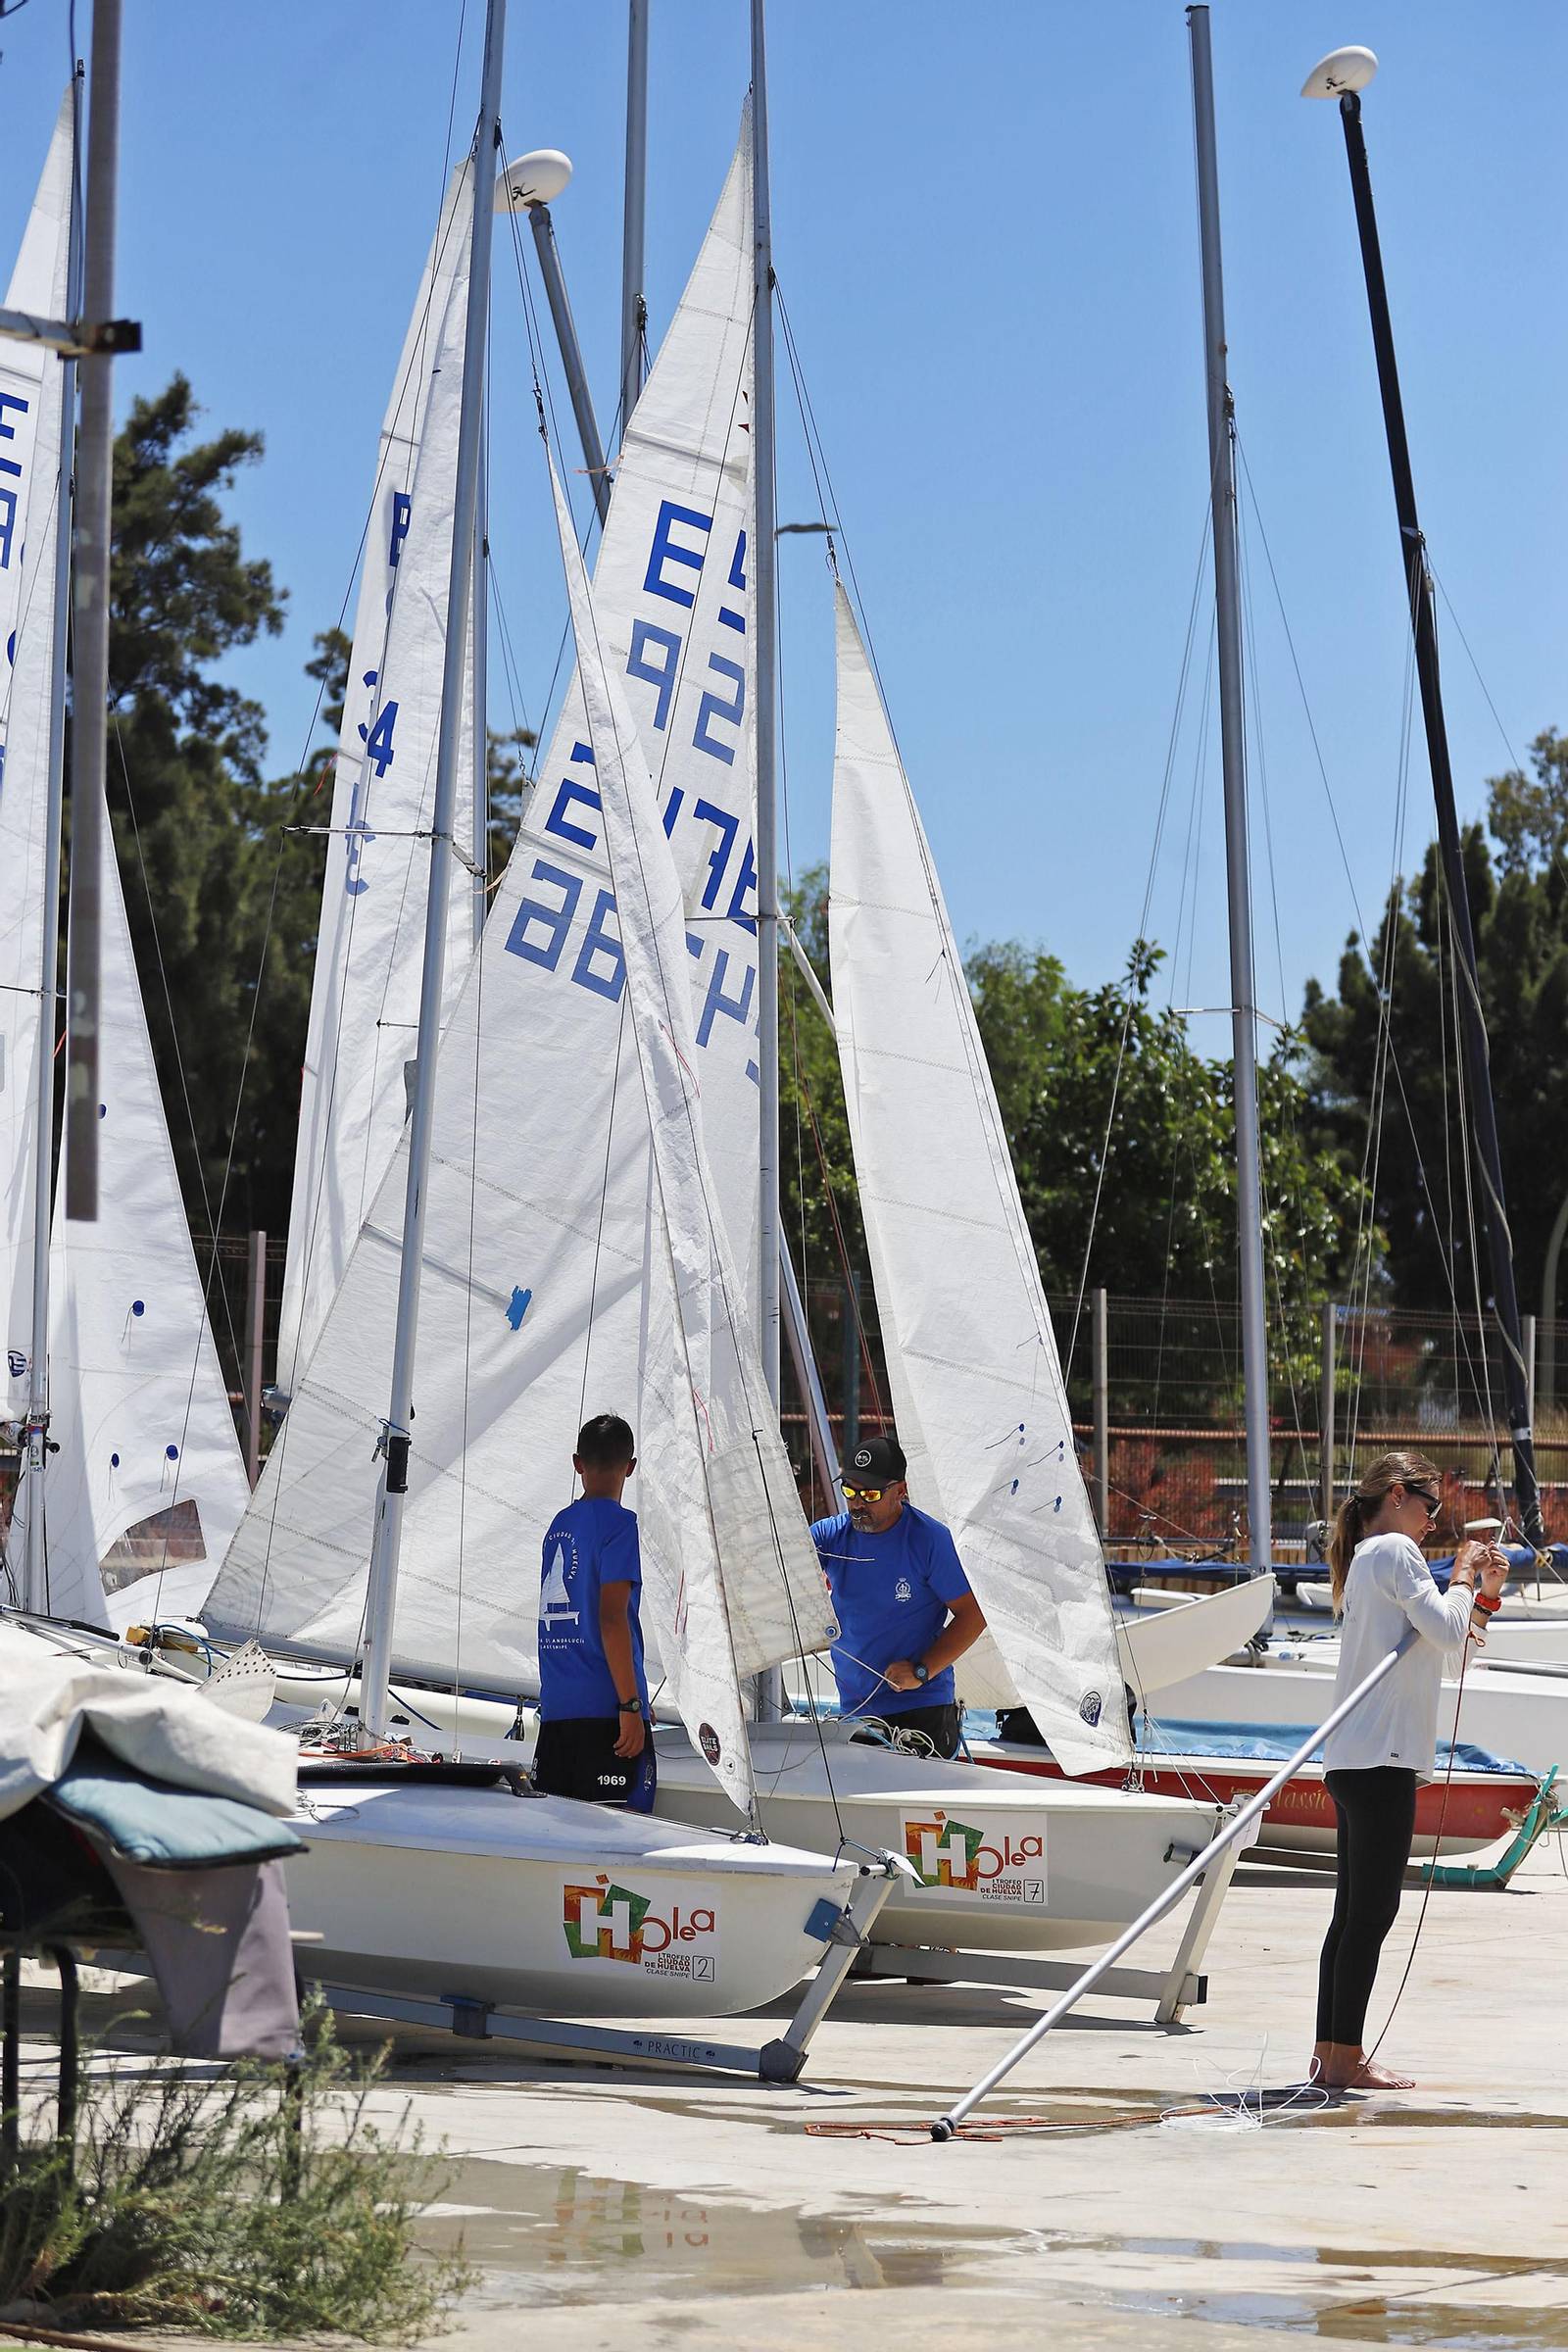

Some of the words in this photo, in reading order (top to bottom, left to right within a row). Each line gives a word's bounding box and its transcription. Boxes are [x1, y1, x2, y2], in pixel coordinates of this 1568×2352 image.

[549, 1531, 571, 1541] CIUDAD
[567, 1548, 578, 1580] HUELVA
[597, 1775, 627, 1786] 1969
[1027, 1883, 1040, 1901] 7
[657, 1963, 691, 1973] HUELVA
[658, 1958, 690, 1967] CIUDAD
[698, 1958, 710, 1978] 2
[648, 2040, 701, 2059] PRACTIC
